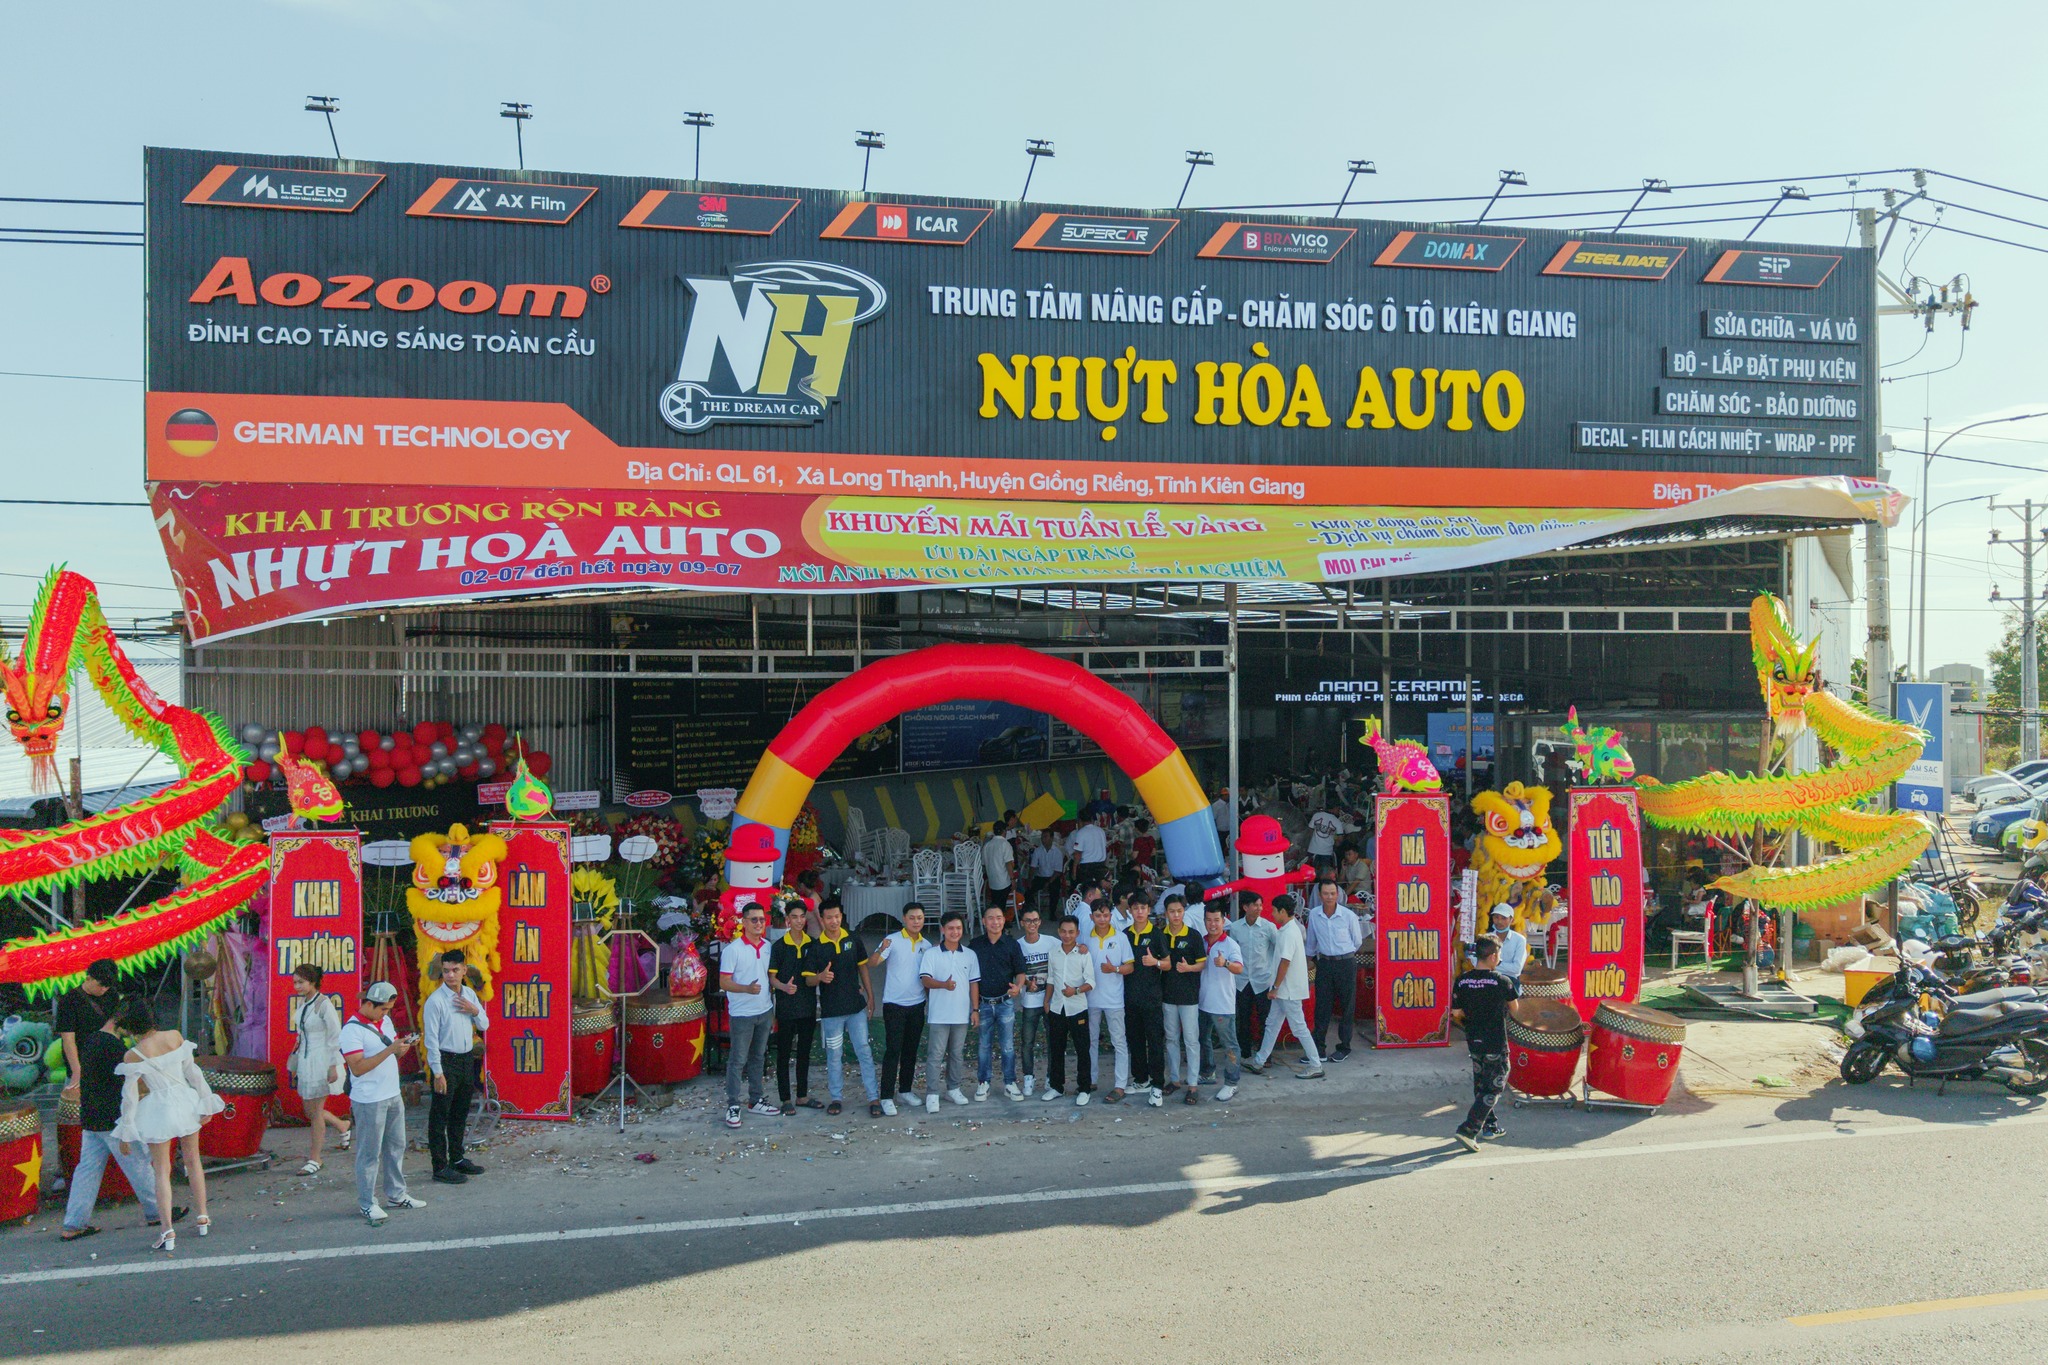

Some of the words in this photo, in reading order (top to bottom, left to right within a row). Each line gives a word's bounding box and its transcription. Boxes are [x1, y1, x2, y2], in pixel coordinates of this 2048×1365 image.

[281, 184, 347, 198] LEGEND
[496, 194, 524, 210] AX
[531, 196, 566, 211] Film
[698, 196, 727, 212] 3M
[916, 216, 958, 233] ICAR
[1061, 226, 1148, 242] SUPERCAR
[1264, 232, 1328, 248] BRAVIGO
[1264, 245, 1282, 254] Enjoy
[1424, 240, 1488, 261] DOMAX
[188, 257, 588, 318] Aozoom
[928, 286, 1017, 318] TRUNG
[1026, 283, 1082, 320] TÂM
[1092, 287, 1163, 324] NÂNG
[1171, 285, 1222, 325] CẤP
[1242, 293, 1316, 329] CHĂM
[1325, 298, 1374, 331] SÓC
[1382, 297, 1397, 332] Ô
[1405, 300, 1435, 333] TÔ
[1444, 301, 1498, 335] KIÊN
[1507, 309, 1576, 338] GIANG
[1715, 312, 1746, 336] SỬA
[1751, 316, 1795, 338] CHỮA
[1810, 316, 1832, 340] VÁ
[1836, 318, 1857, 342] VỎ
[188, 318, 249, 344] ĐỈNH
[257, 326, 312, 346] CAO
[319, 324, 388, 349] TĂNG
[396, 325, 465, 352] SÁNG
[472, 328, 540, 354] TOÀN
[546, 328, 595, 356] CẦU
[1674, 350, 1696, 376] ĐỘ
[1712, 349, 1743, 374] LẮP
[1747, 354, 1779, 380] ĐẶT
[1783, 359, 1815, 382] PHỤ
[1819, 357, 1856, 382] KIỆN
[700, 401, 730, 413] THE
[734, 402, 786, 414] DREAM
[790, 404, 820, 416] CAR
[977, 346, 1177, 441] NHỰT
[1194, 342, 1332, 428] HÒA
[1346, 366, 1526, 431] AUTO
[1666, 390, 1715, 413] CHĂM
[1719, 392, 1750, 414] SÓC
[1766, 392, 1798, 416] BẢO
[1803, 395, 1857, 418] DƯỠNG
[234, 421, 364, 446] GERMAN
[374, 424, 570, 450] TECHNOLOGY
[1581, 427, 1628, 448] DECAL
[1642, 429, 1676, 449] FILM
[1679, 426, 1717, 450] CÁCH
[1721, 429, 1762, 454] NHIỆT
[1775, 433, 1815, 452] WRAP
[1830, 435, 1856, 453] PPF
[627, 461, 663, 484] Địa
[716, 463, 750, 484] QL
[753, 465, 784, 487] 61,
[830, 467, 882, 490] Long
[887, 469, 958, 492] Thạnh,
[960, 472, 1024, 494] Huyện
[1029, 470, 1088, 496] Giồng
[1093, 473, 1153, 497] Riềng,
[1155, 475, 1197, 493] Tỉnh
[1201, 476, 1244, 494] Kiên
[1250, 477, 1305, 499] Giang
[1653, 483, 1692, 504] Điện
[224, 508, 333, 538] KHAI
[343, 502, 510, 531] TRƯƠNG
[521, 498, 603, 520] RỘN
[614, 498, 722, 518] RÀNG
[828, 506, 958, 536] KHUYẾN
[968, 513, 1030, 538] MÃI
[1035, 510, 1121, 538] TUẦN
[1128, 508, 1168, 538] LỄ
[1173, 515, 1265, 535] VÀNG
[208, 539, 406, 610] NHỰT
[418, 523, 578, 572] HOÀ
[594, 526, 781, 558] AUTO
[778, 563, 825, 583] MỜI
[830, 565, 881, 582] ANH
[885, 568, 918, 580] EM
[1199, 558, 1288, 580] NGHIỆM
[924, 545, 952, 560] ƯU
[1002, 546, 1060, 564] NGẬP
[1063, 544, 1136, 562] TRÀNG
[460, 566, 526, 586] 02-07
[533, 562, 574, 580] đến
[580, 560, 615, 576] hết
[622, 561, 672, 576] ngày
[679, 561, 741, 576] 09-07
[350, 808, 383, 822] KHAI
[1400, 828, 1426, 866] MÃ
[1587, 820, 1622, 860] TIỀN
[293, 880, 341, 918] KHAI
[508, 864, 547, 908] LÀM
[1397, 876, 1430, 914] ĐÁO
[1590, 870, 1622, 907] VÀO
[277, 931, 356, 976] TRƯƠNG
[513, 921, 540, 964] ĂN
[1387, 924, 1440, 962] THÀNH
[1590, 918, 1625, 954] NHƯ
[503, 975, 552, 1019] PHÁT
[1392, 973, 1436, 1010] CÔNG
[1584, 963, 1626, 999] NƯỚC
[510, 1030, 544, 1074] TÀI
